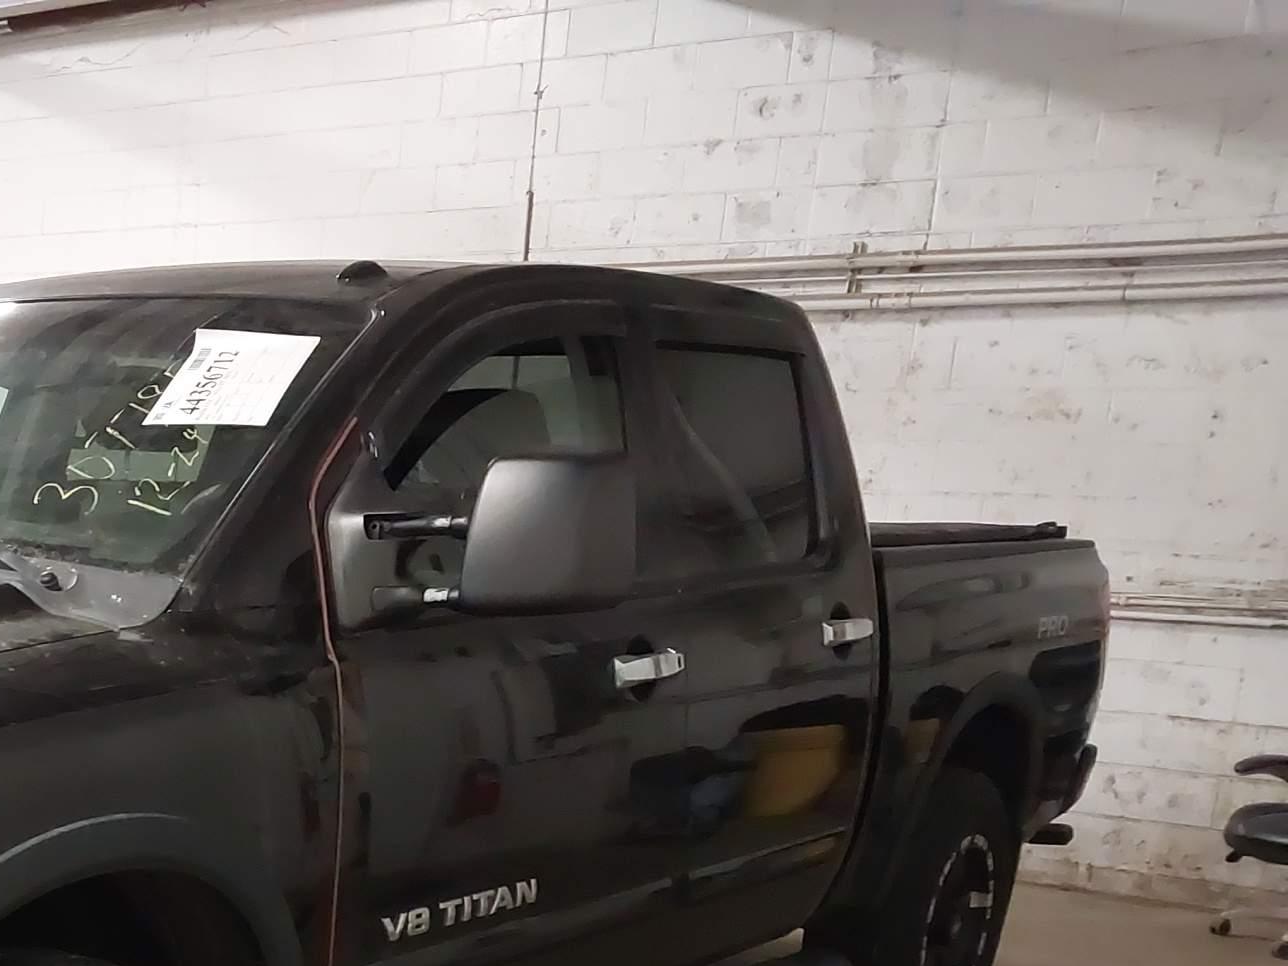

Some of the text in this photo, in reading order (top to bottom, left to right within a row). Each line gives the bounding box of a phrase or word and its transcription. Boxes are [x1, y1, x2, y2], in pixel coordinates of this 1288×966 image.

[179, 350, 241, 416] 44356712
[380, 878, 538, 942] V8 TITAN
